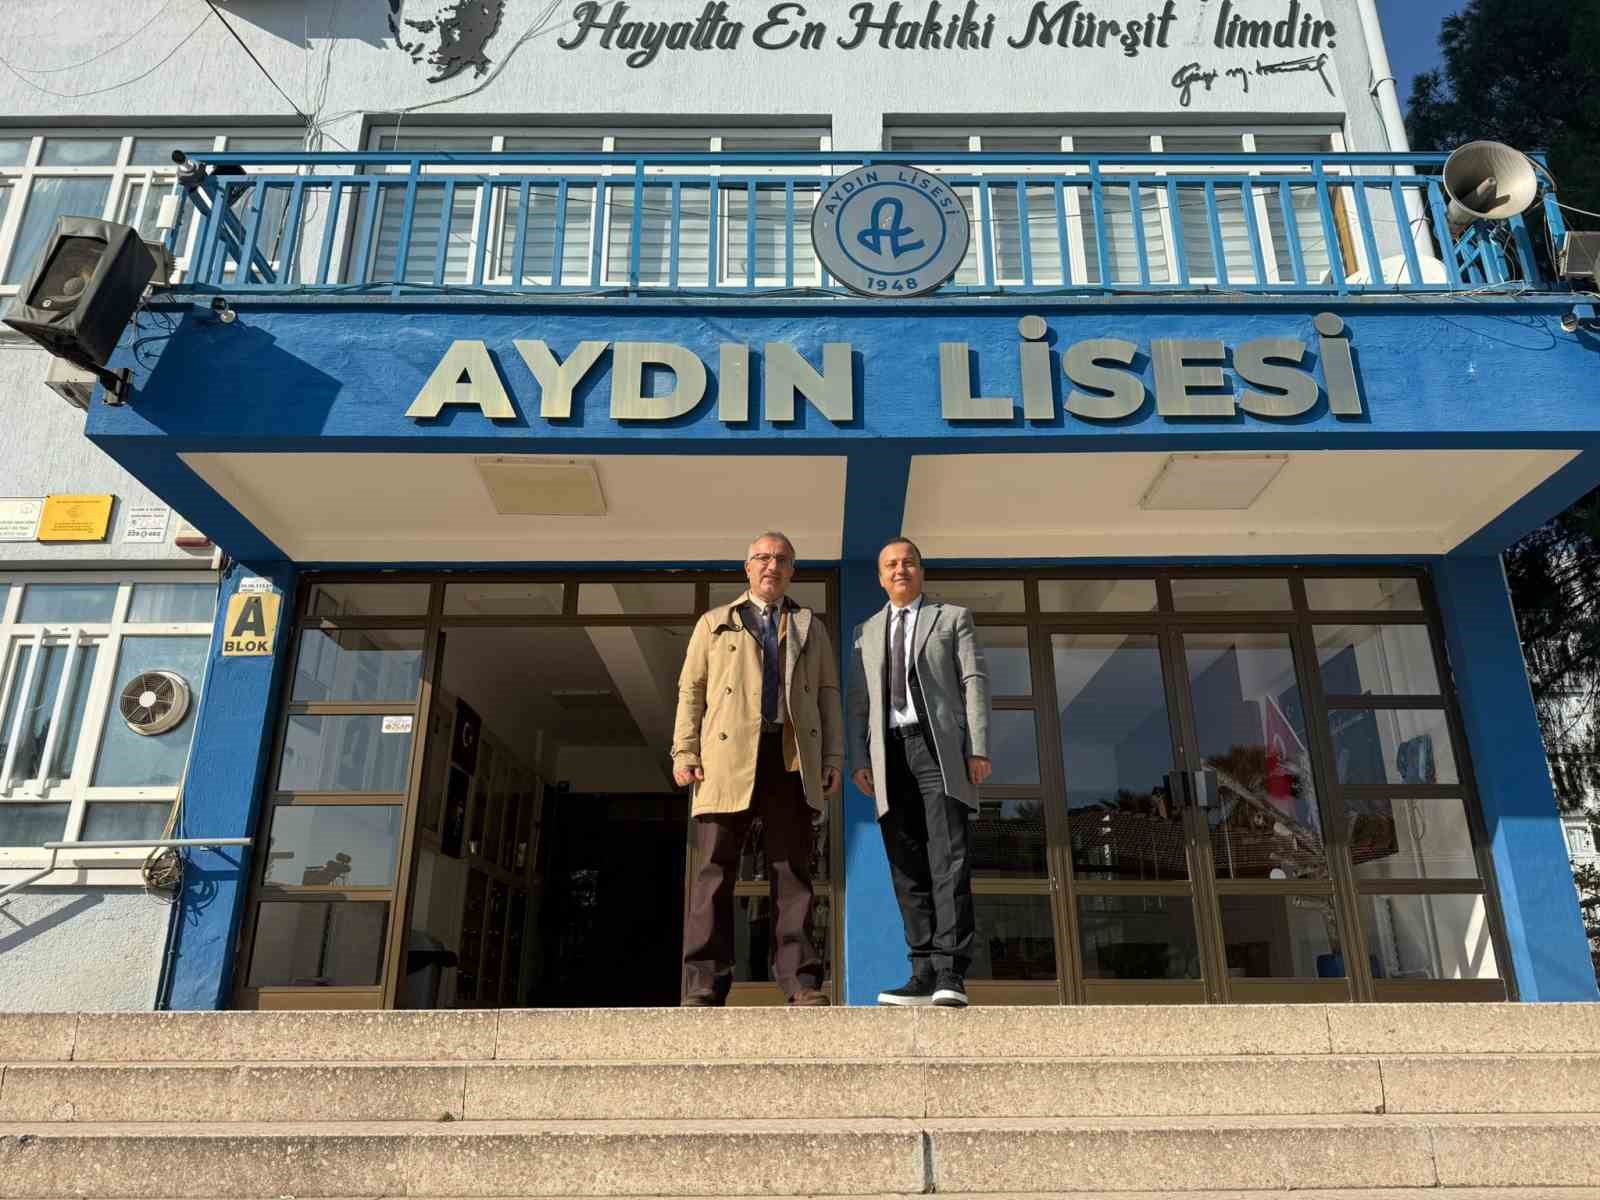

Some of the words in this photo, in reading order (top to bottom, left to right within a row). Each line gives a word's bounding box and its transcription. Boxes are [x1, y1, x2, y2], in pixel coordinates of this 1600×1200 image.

[558, 0, 744, 69] Hayatta
[753, 3, 826, 50] En
[836, 0, 995, 50] Hakiki
[1008, 0, 1177, 57] Mürşit
[824, 171, 879, 216] AYDIN
[898, 171, 961, 216] LİSESİ
[867, 277, 918, 292] 1948
[404, 339, 855, 422] AYDIN
[939, 312, 1364, 420] LİSESİ
[231, 596, 266, 637] A
[223, 640, 269, 652] BLOK
